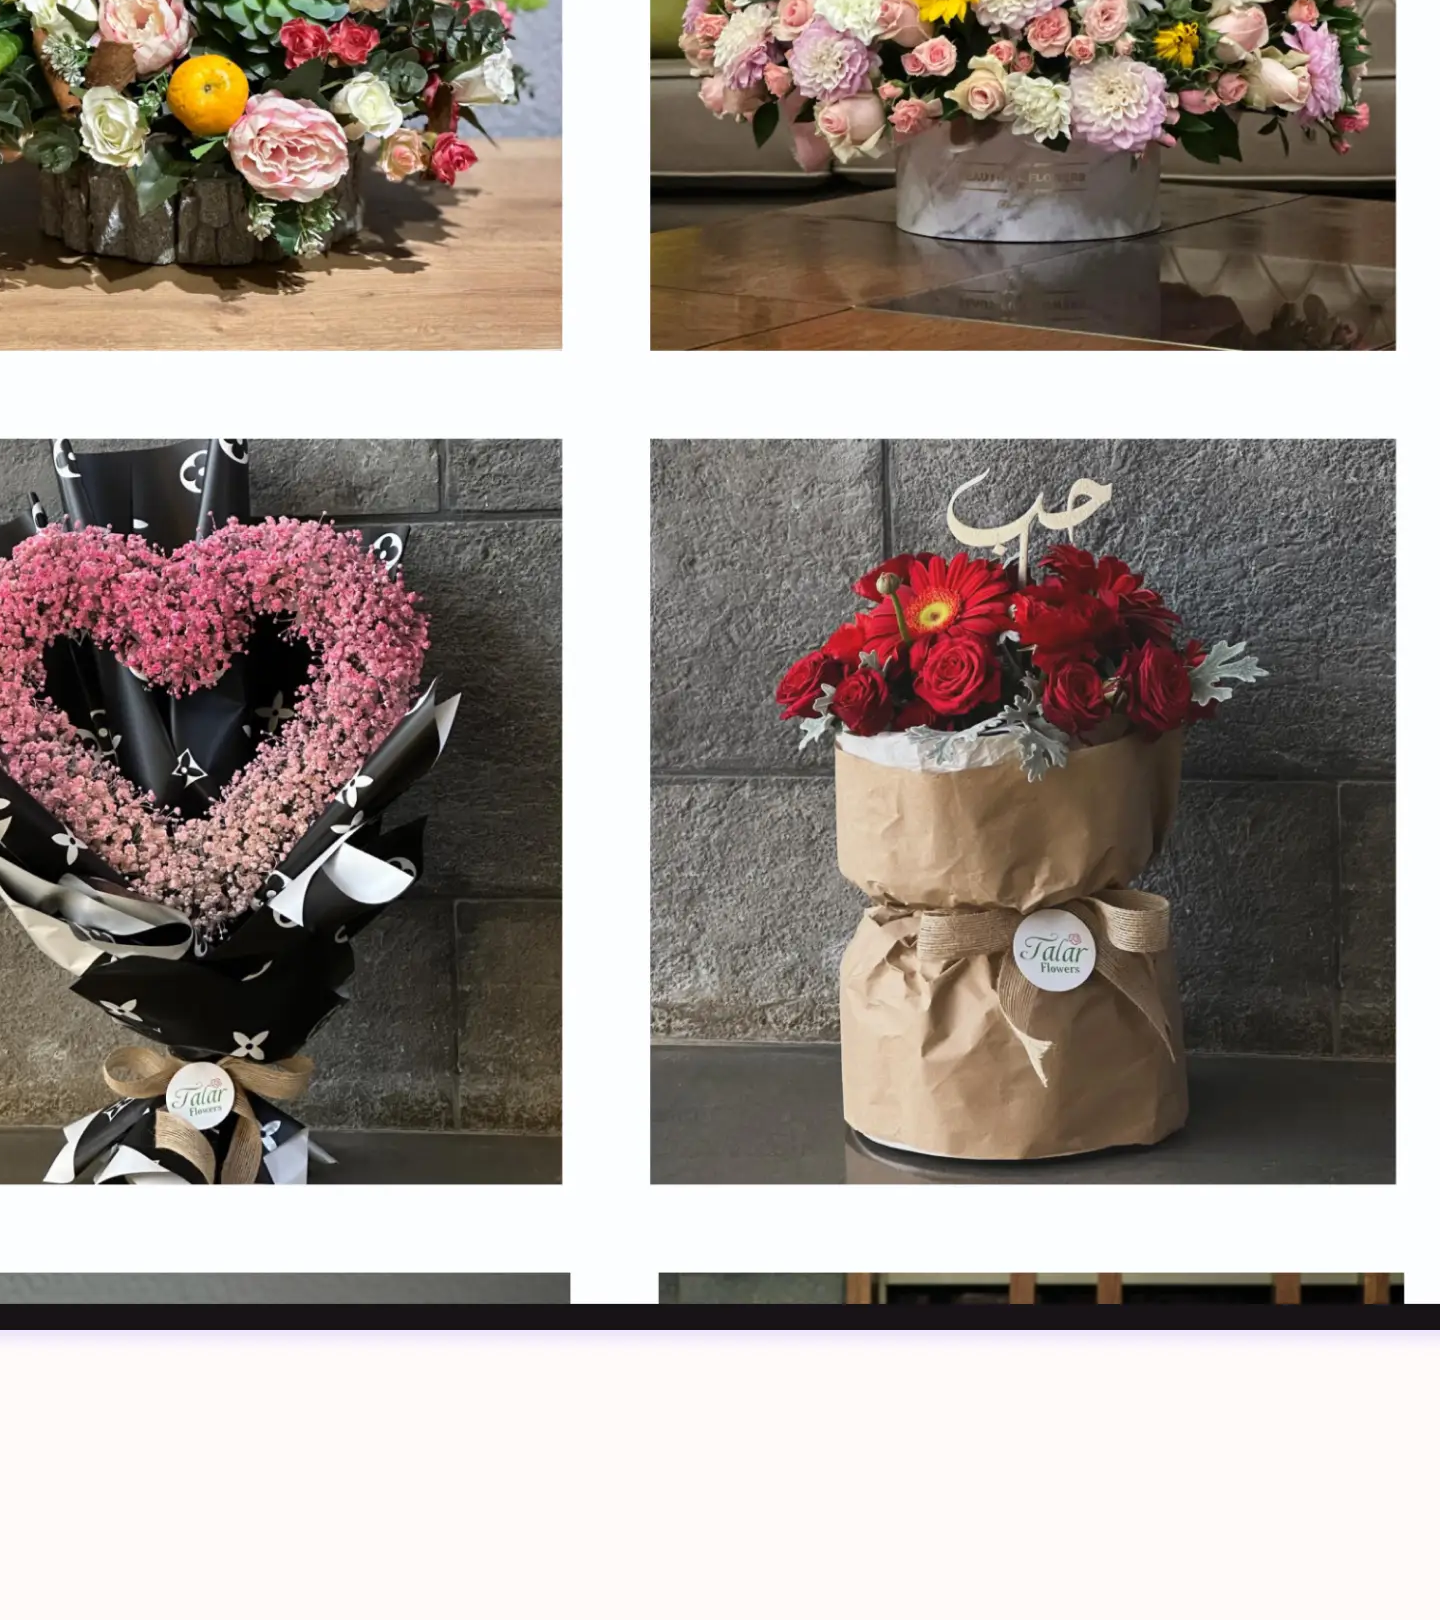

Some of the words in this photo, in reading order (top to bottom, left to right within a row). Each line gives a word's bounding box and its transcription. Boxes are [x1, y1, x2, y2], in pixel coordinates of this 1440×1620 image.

[946, 467, 1113, 556] حب
[1019, 933, 1089, 963] Talar
[1040, 961, 1080, 974] Flowers
[171, 1082, 228, 1109] Talar
